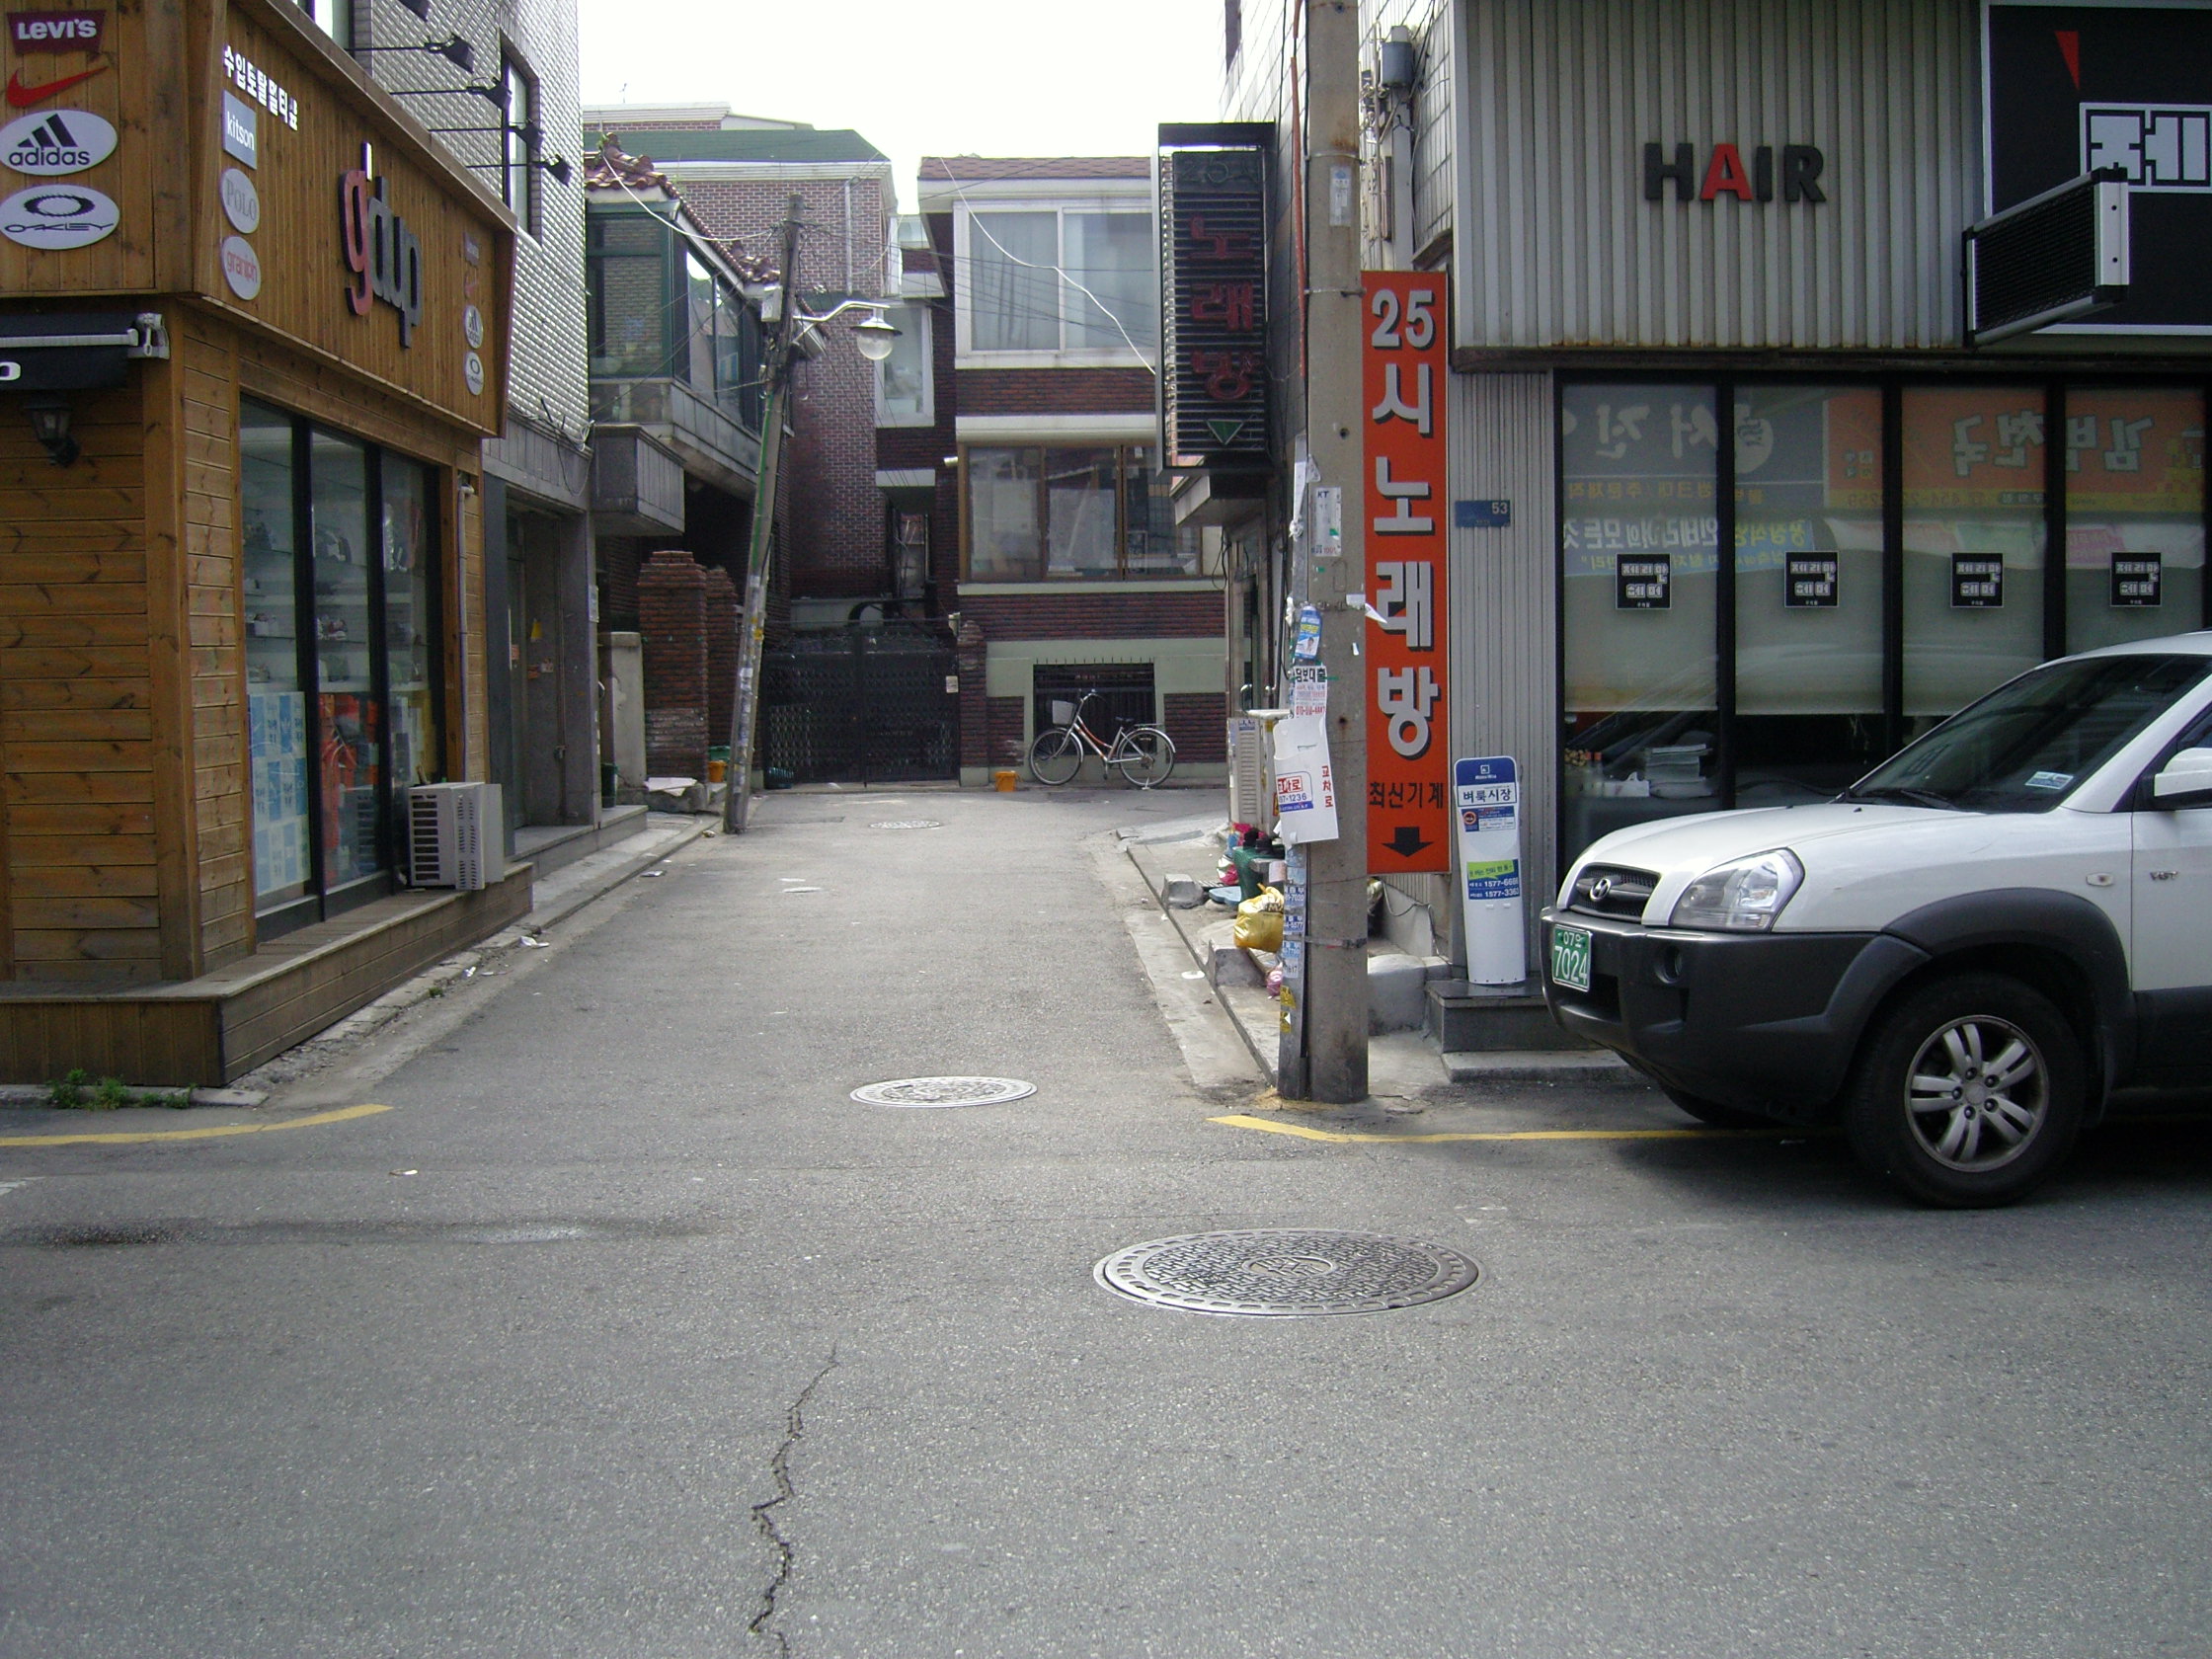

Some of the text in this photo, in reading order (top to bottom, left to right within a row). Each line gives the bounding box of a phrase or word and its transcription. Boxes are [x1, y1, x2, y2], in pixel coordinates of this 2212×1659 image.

[227, 110, 255, 152] kitson
[9, 145, 90, 166] adidas
[1644, 142, 1826, 202] HAIR
[226, 179, 258, 221] POLO
[4, 221, 115, 234] OAKLEY
[1492, 502, 1509, 514] 53
[1296, 667, 1326, 683] 담보대출
[1322, 764, 1334, 808] 교차로
[1369, 781, 1444, 809] 최신기계
[1462, 788, 1512, 803] 벼룩시장
[1554, 945, 1588, 985] 7024
